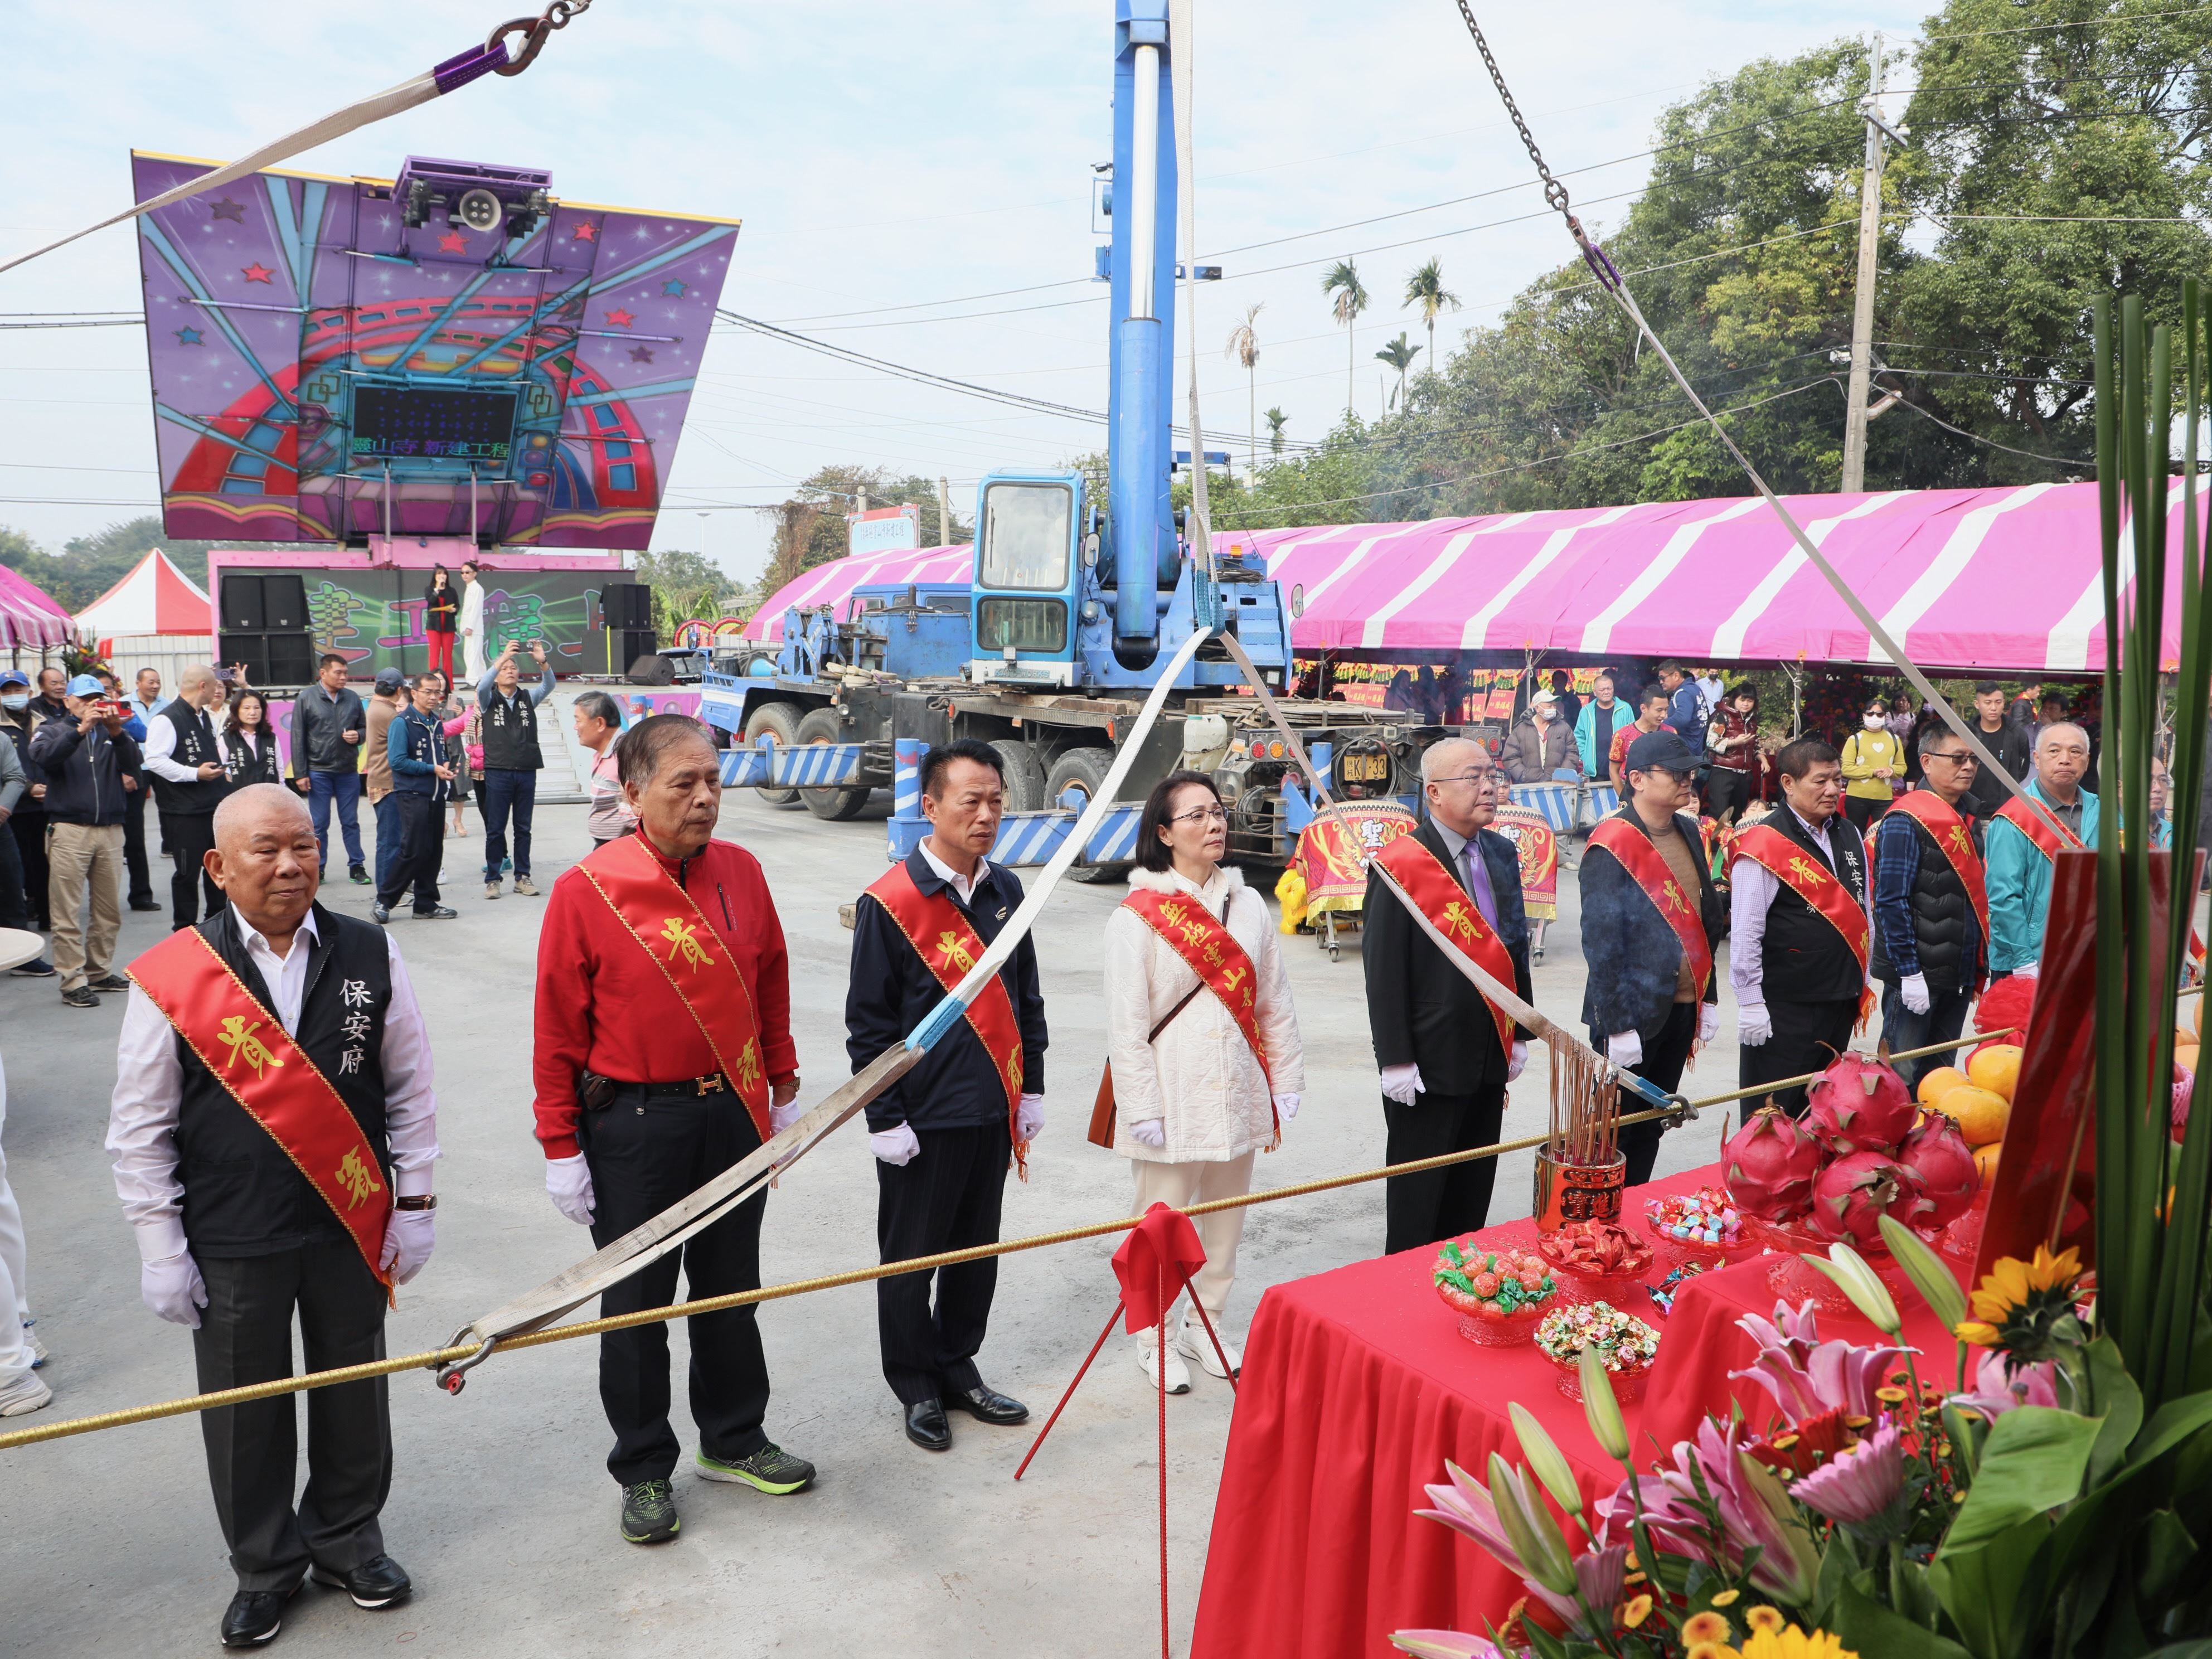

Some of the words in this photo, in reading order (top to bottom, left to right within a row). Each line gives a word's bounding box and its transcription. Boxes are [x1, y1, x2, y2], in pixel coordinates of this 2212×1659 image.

[353, 437, 418, 455] 靈山寺
[424, 439, 510, 458] 新建工程
[266, 746, 275, 775] 保安府
[339, 978, 374, 1075] 保安府
